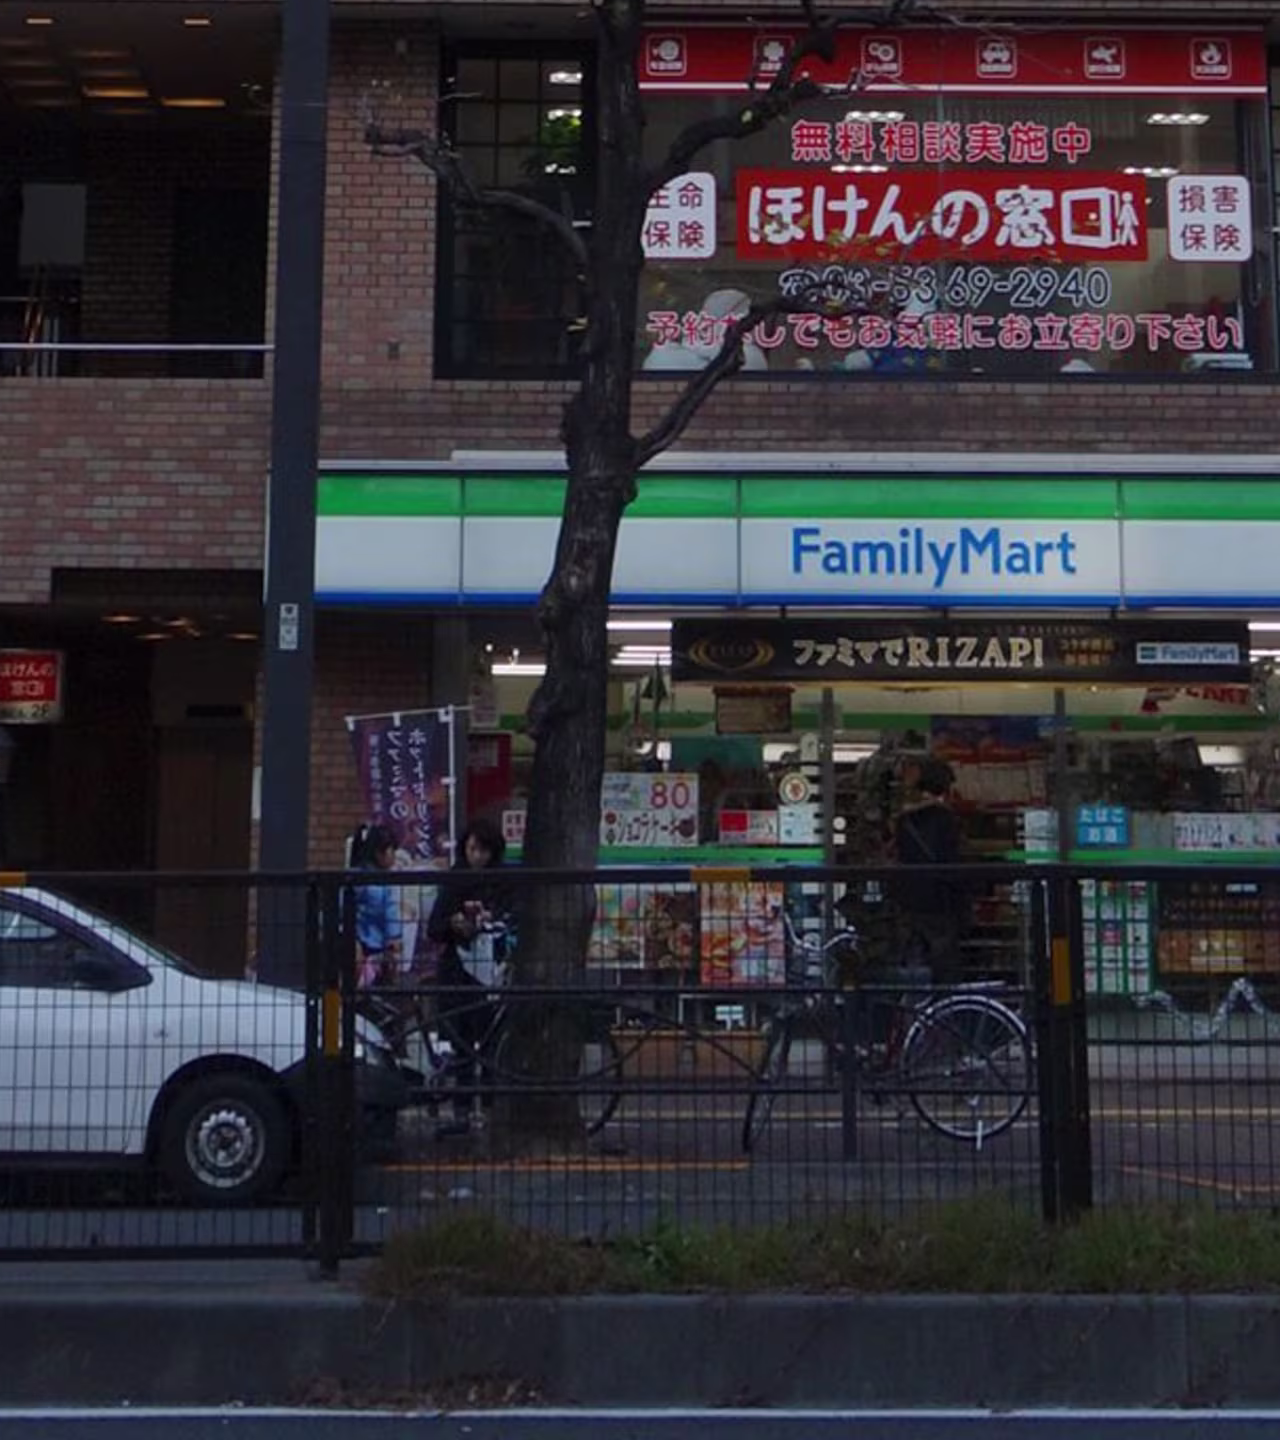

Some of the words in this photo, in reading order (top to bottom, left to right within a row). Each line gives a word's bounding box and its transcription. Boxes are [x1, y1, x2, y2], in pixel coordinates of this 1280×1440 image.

[791, 120, 1092, 163] 無料相談実施中
[644, 182, 704, 209] 生命
[1178, 184, 1240, 214] 損害
[748, 185, 1116, 249] ほけんの窓口
[645, 220, 705, 249] 保険
[1179, 221, 1241, 252] 保険
[790, 526, 1078, 588] FamilyMart
[1160, 644, 1236, 663] FamilyMart
[0, 662, 56, 678] ほけんの
[650, 781, 691, 810] 80
[1080, 807, 1125, 824] たばこ
